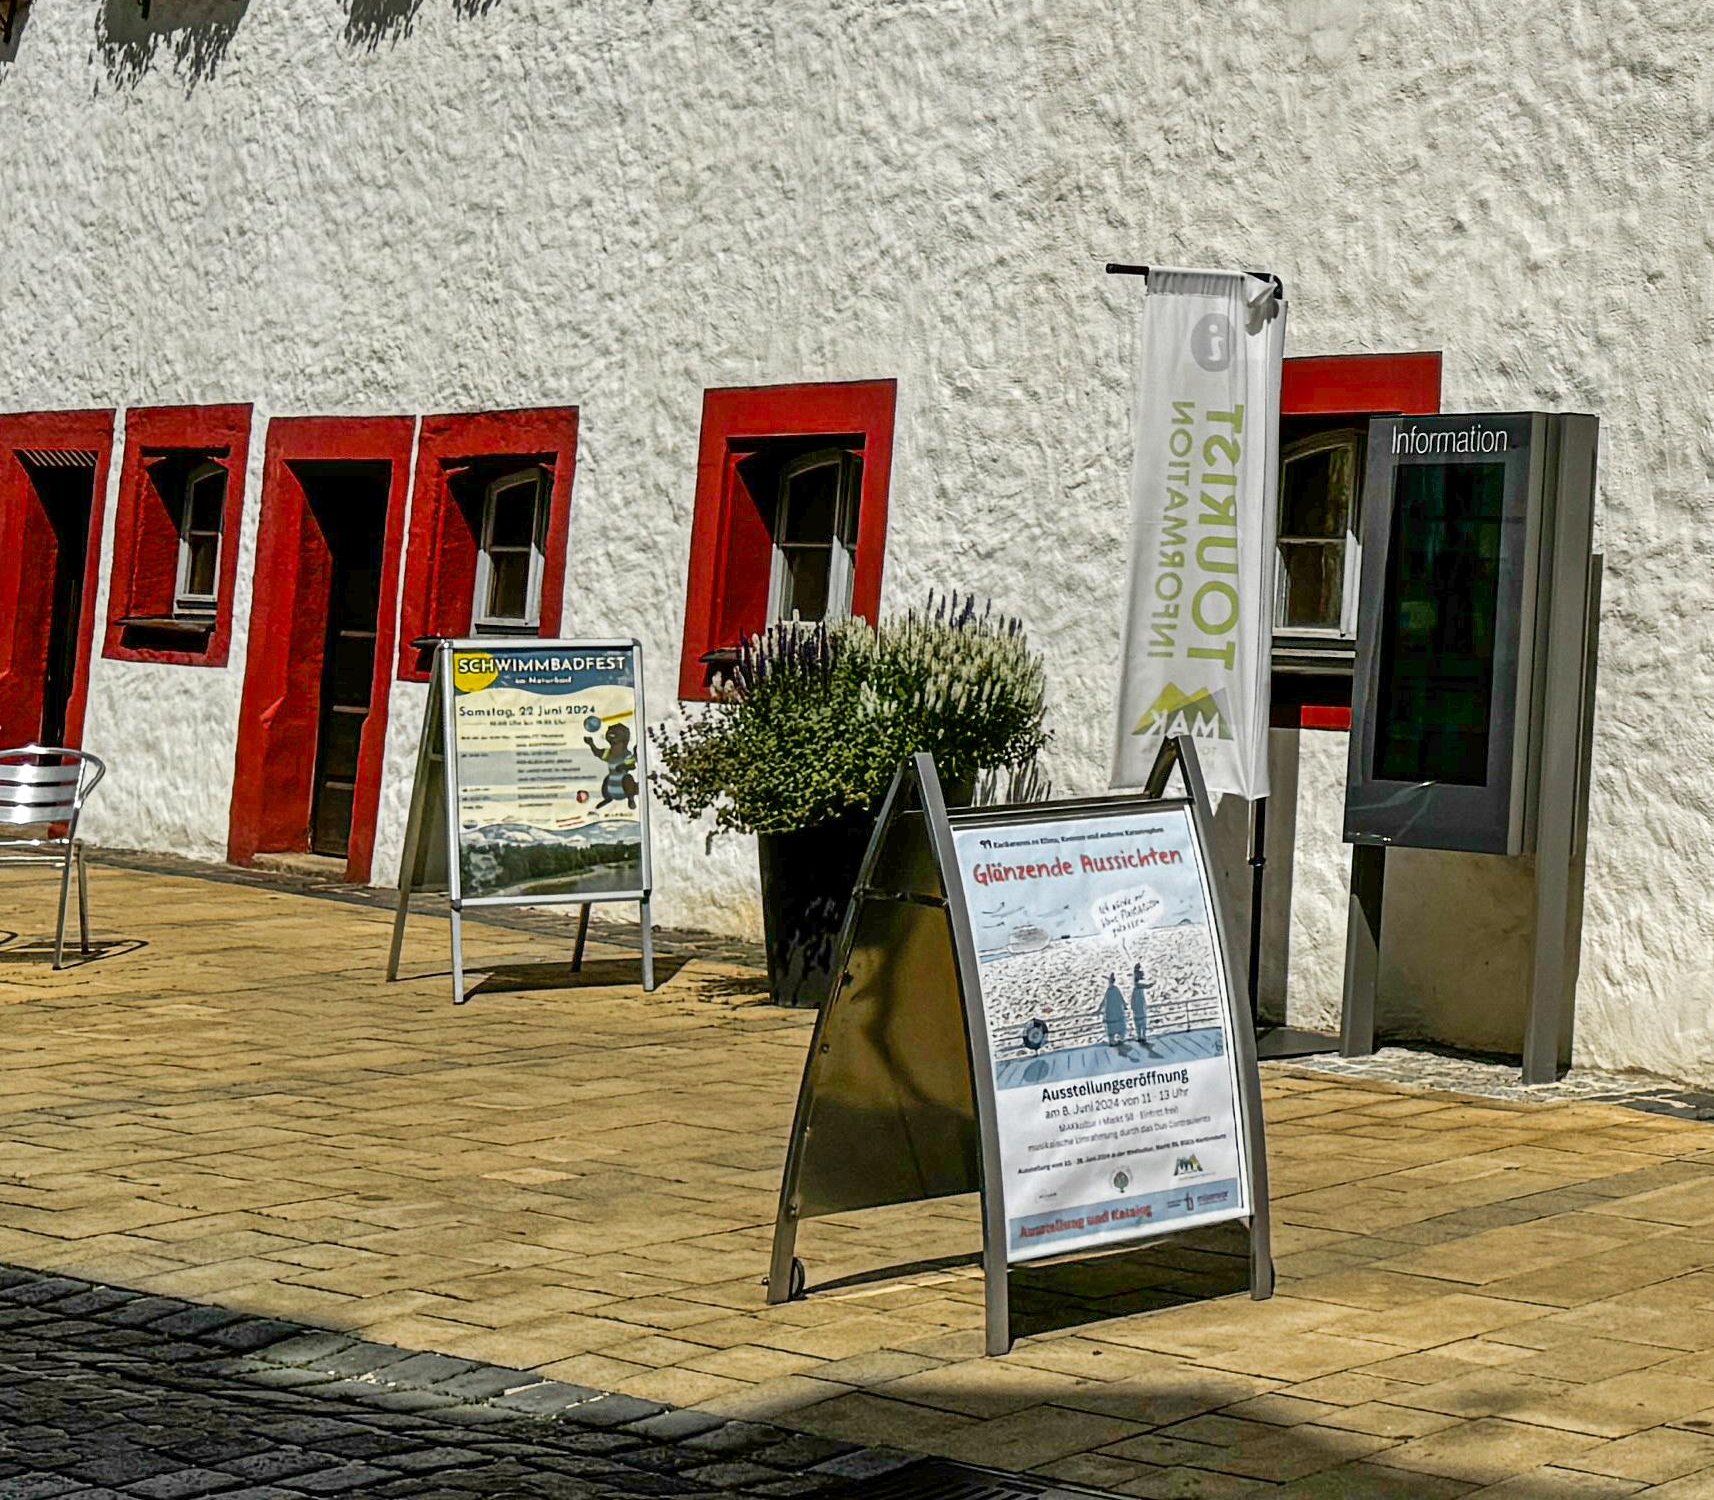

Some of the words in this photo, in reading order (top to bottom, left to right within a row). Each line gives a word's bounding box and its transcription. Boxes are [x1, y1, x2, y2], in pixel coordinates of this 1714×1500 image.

[1391, 424, 1510, 456] Information
[458, 656, 626, 675] SCHWIMMBADFEST
[519, 706, 534, 716] 22
[538, 705, 562, 716] Juni
[565, 705, 595, 715] 2024
[973, 856, 1074, 885] Glänzende
[1080, 847, 1183, 874] Aussichten
[1042, 1068, 1189, 1102] Ausstellungseröffnung
[1095, 1098, 1120, 1112] 2024
[1122, 1096, 1140, 1106] von
[1159, 1089, 1170, 1101] 13
[1172, 1087, 1189, 1099] Uhr
